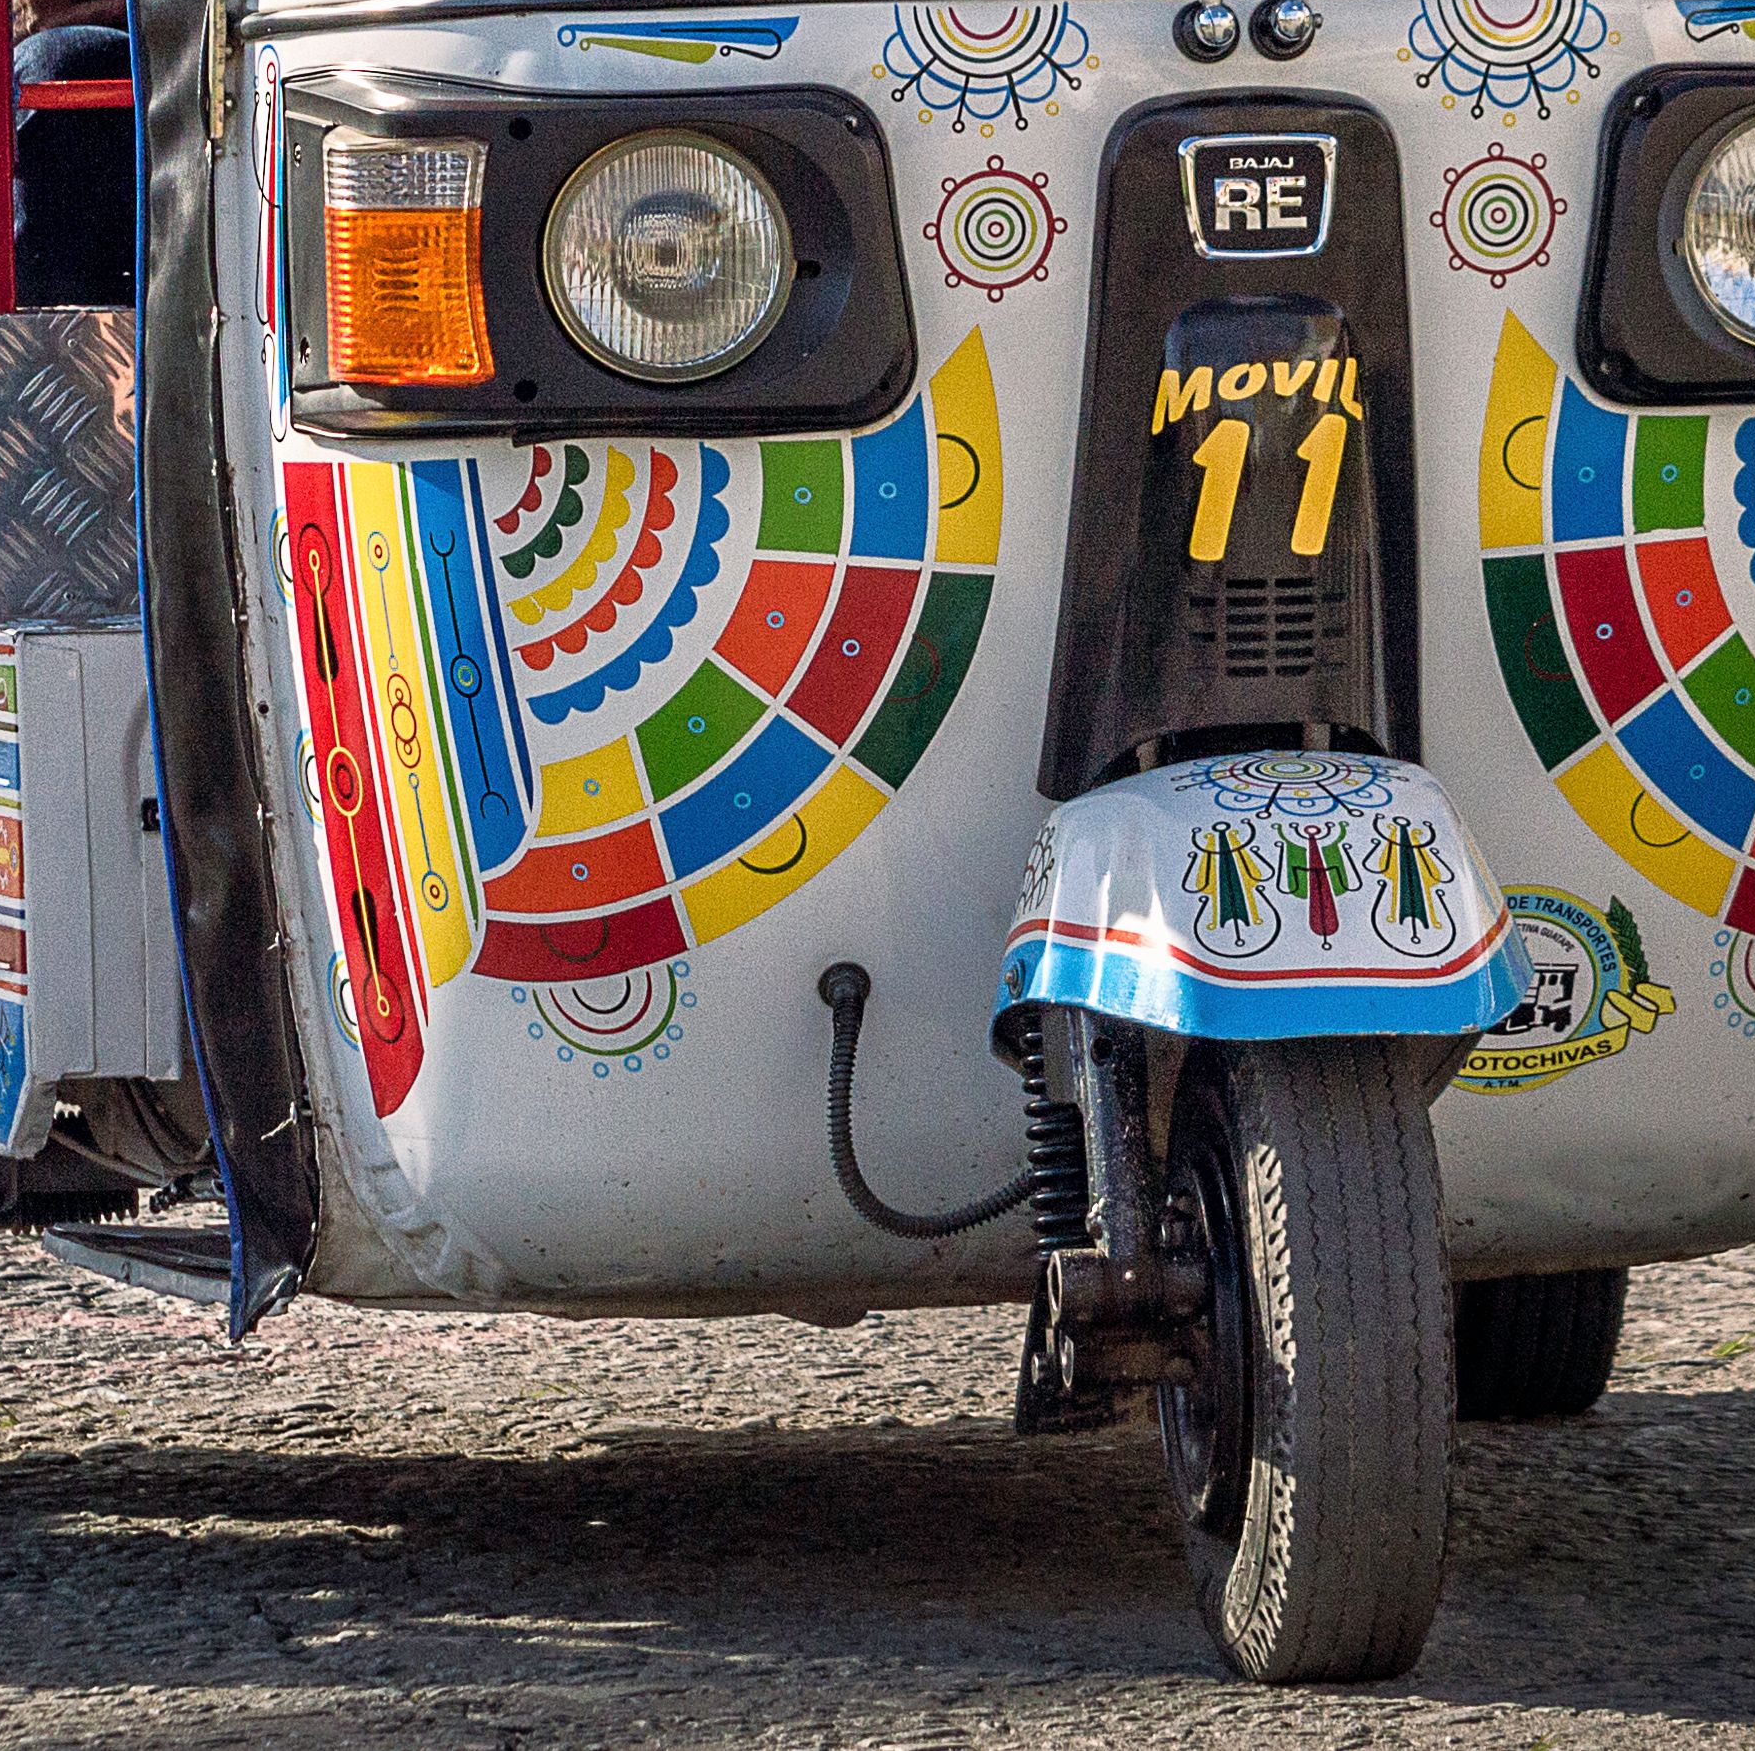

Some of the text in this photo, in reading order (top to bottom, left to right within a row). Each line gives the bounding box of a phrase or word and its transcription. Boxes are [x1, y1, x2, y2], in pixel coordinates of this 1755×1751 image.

[1228, 155, 1294, 170] BAJAJ
[1213, 174, 1308, 232] RE
[1151, 356, 1364, 437] MOVIL
[1188, 412, 1348, 562] 11
[1506, 895, 1617, 974] DE TRANSPORTES
[1462, 1039, 1613, 1072] OTOCHIVAS
